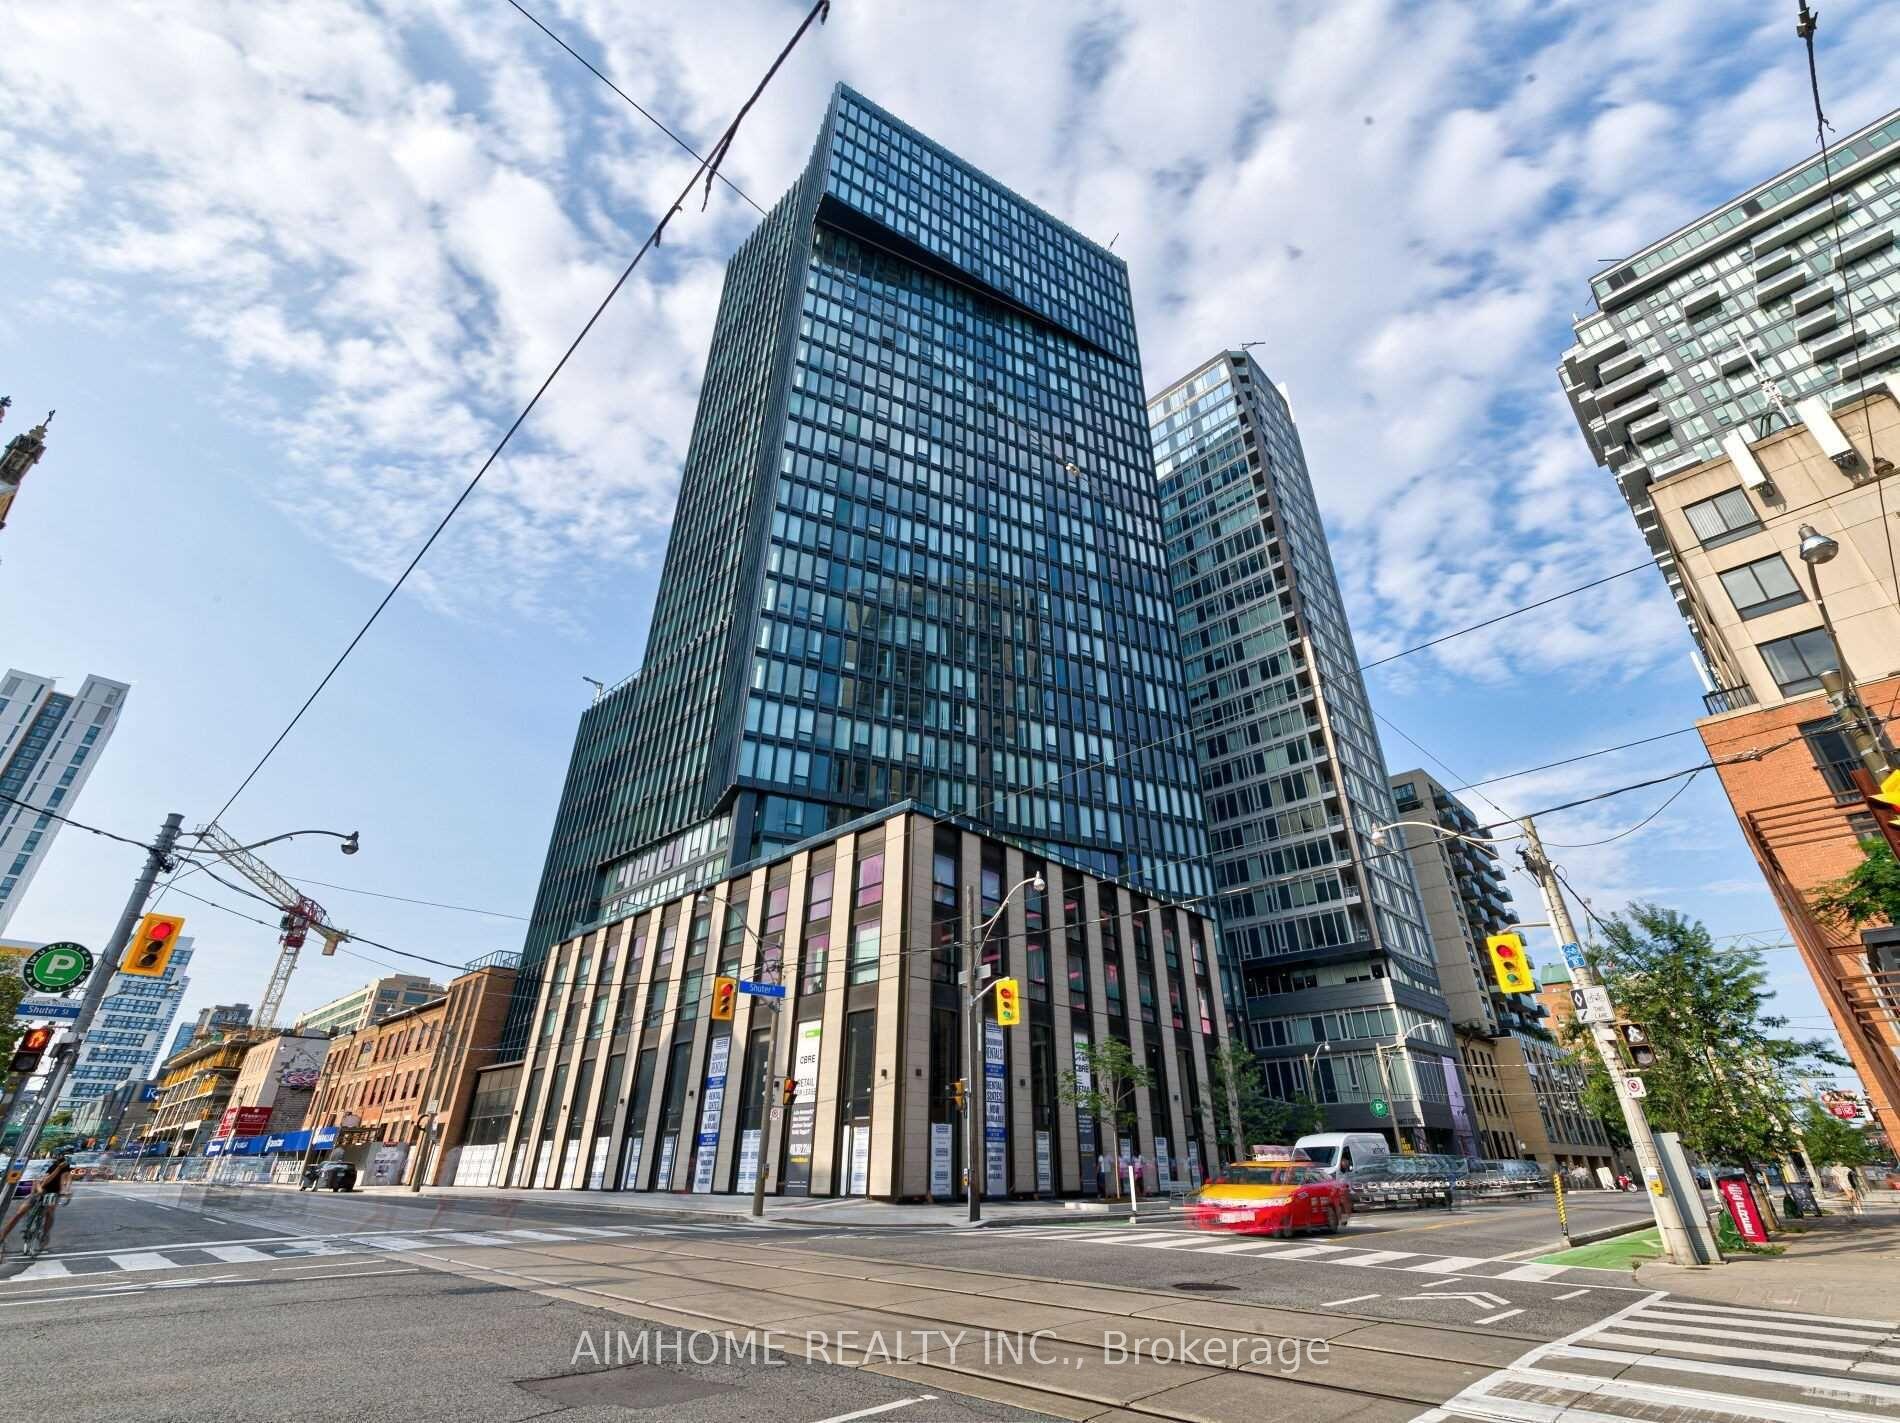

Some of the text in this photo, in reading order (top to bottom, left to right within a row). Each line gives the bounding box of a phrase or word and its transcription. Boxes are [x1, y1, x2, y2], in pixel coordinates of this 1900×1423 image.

[45, 954, 76, 974] P
[750, 983, 771, 993] Shuter
[27, 1005, 58, 1015] Shuter
[799, 1054, 816, 1065] CBRE
